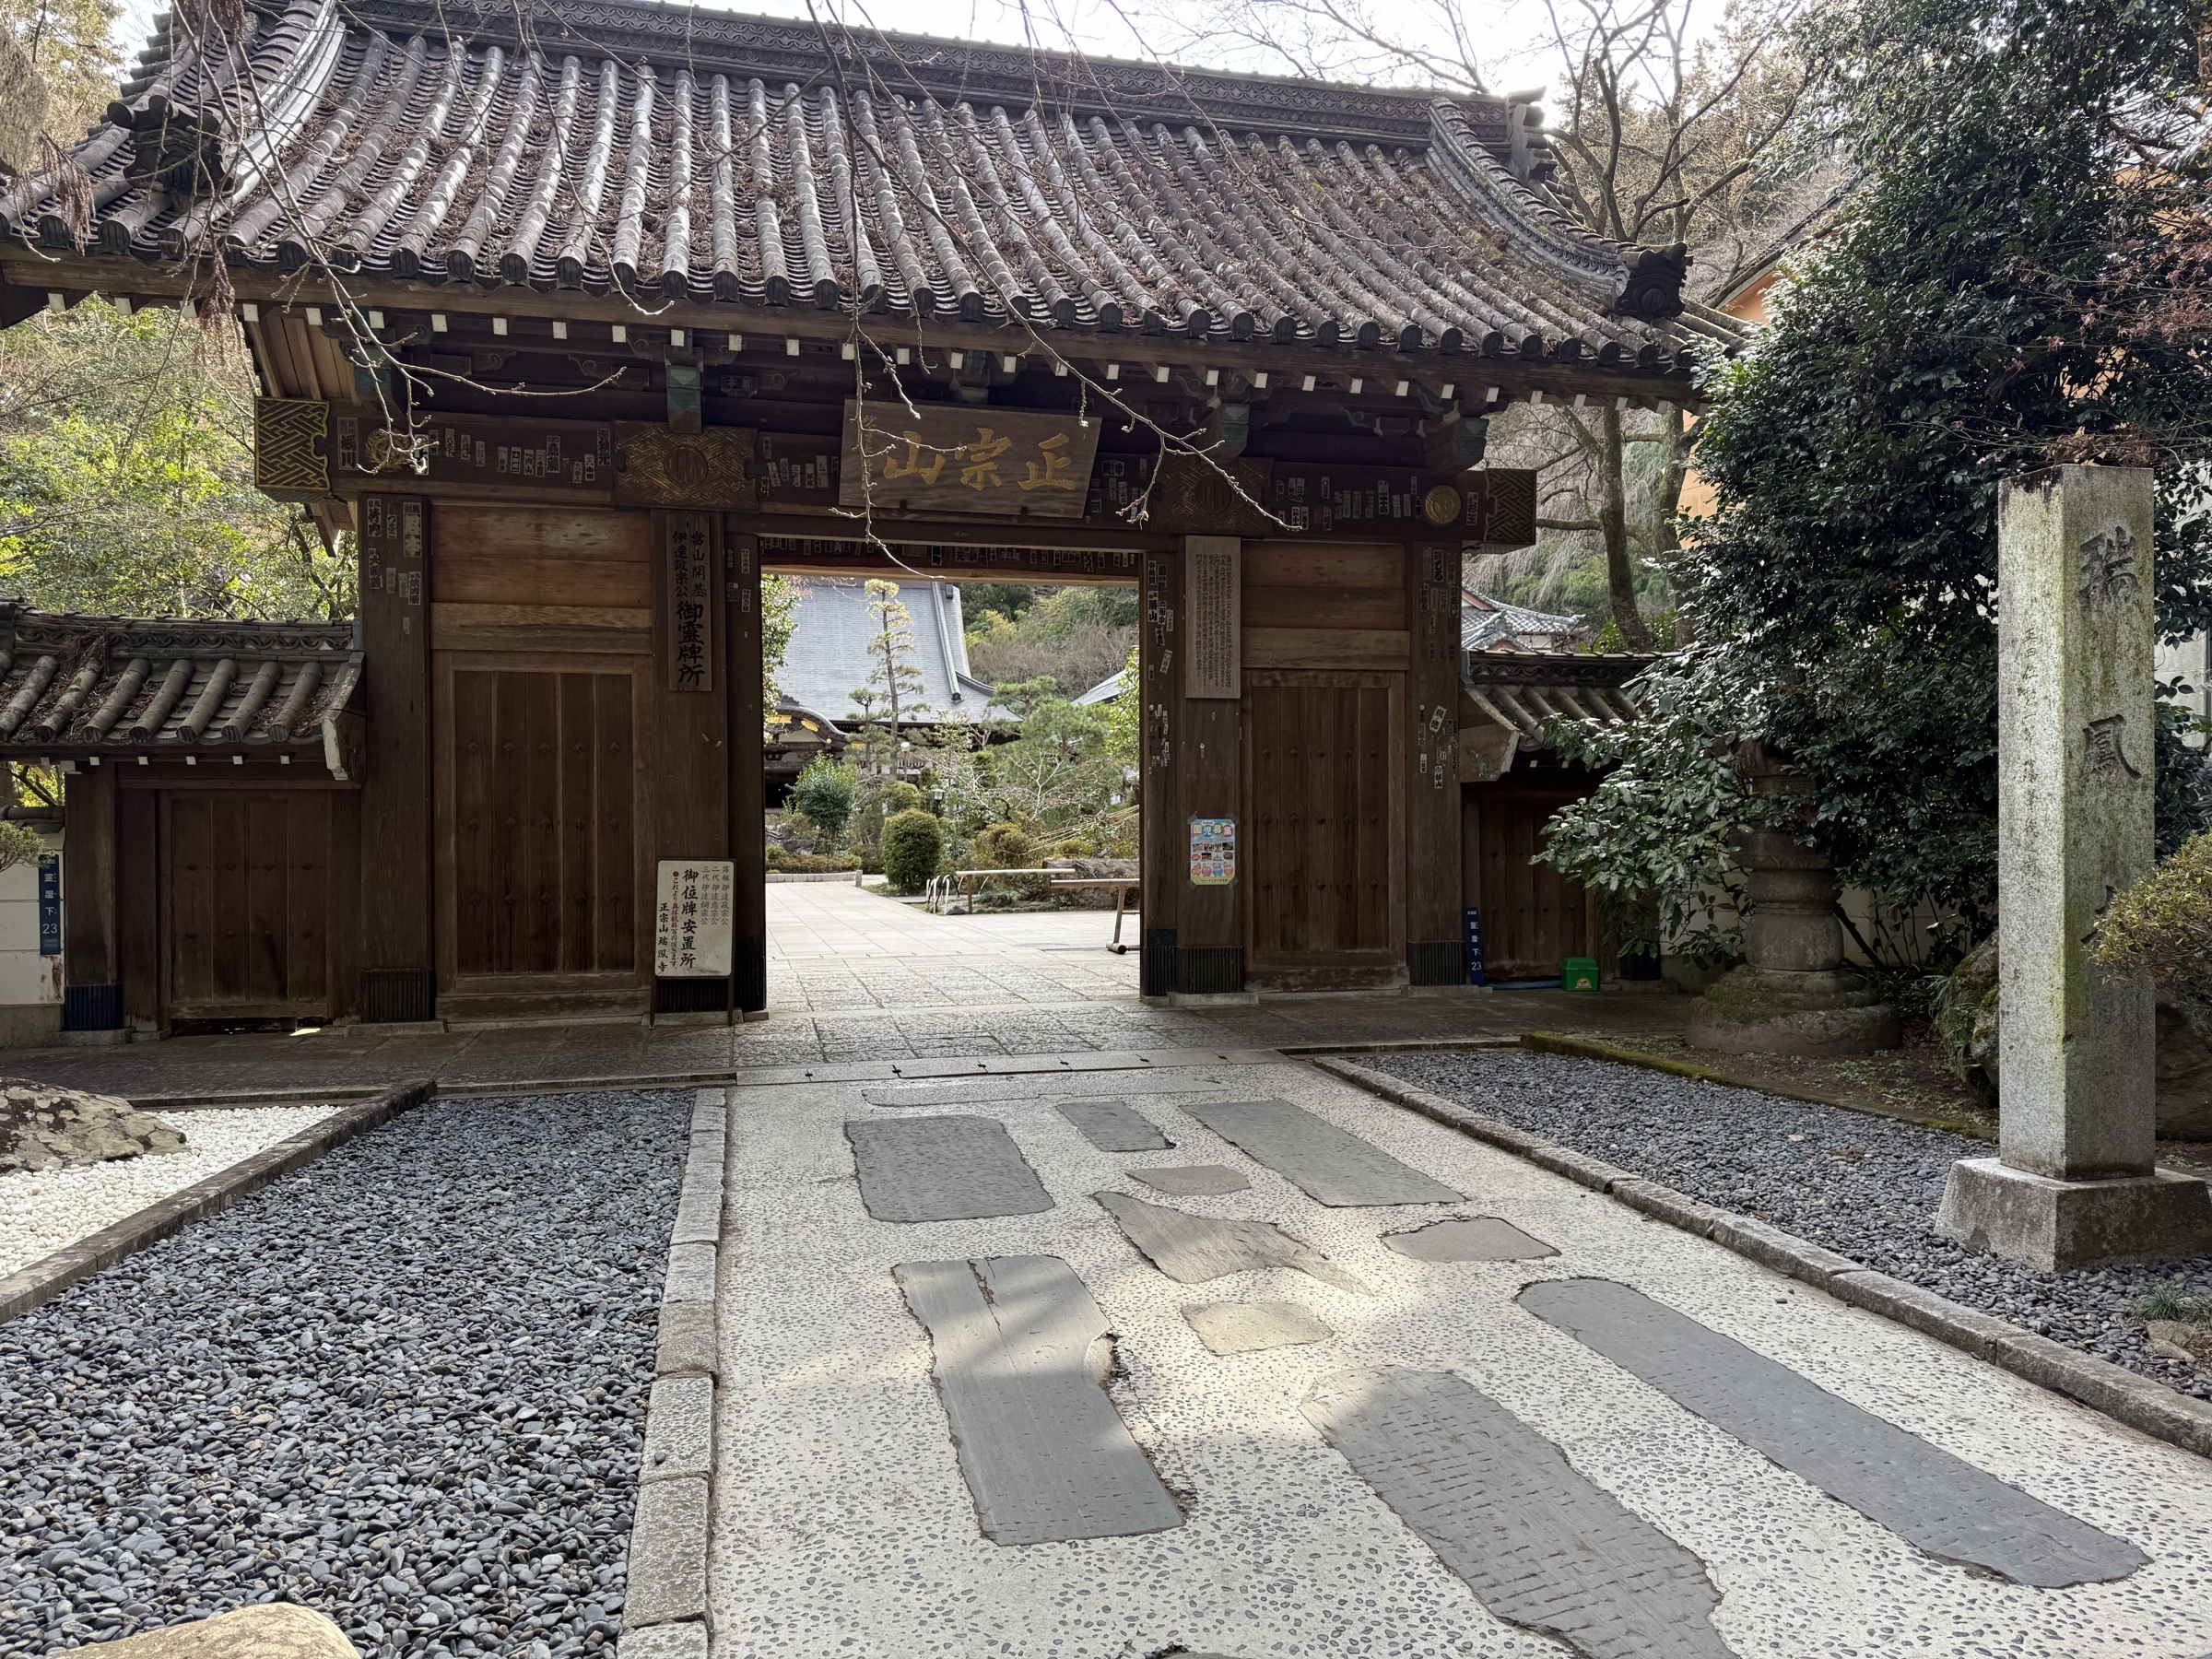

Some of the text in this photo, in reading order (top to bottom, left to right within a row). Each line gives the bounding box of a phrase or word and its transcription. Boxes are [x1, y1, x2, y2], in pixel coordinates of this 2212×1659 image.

[884, 428, 1077, 491] 正宗山
[673, 531, 688, 598] 伊達政宗公
[690, 531, 707, 598] 當山開基
[676, 600, 705, 687] 御霊牌所
[701, 865, 711, 882] 三代
[711, 865, 721, 925] 二代 伊達忠宗公
[42, 923, 58, 935] 23
[680, 868, 699, 969] 御位牌安置所
[721, 884, 731, 925] 伊達政宗公
[1471, 961, 1482, 971] 23
